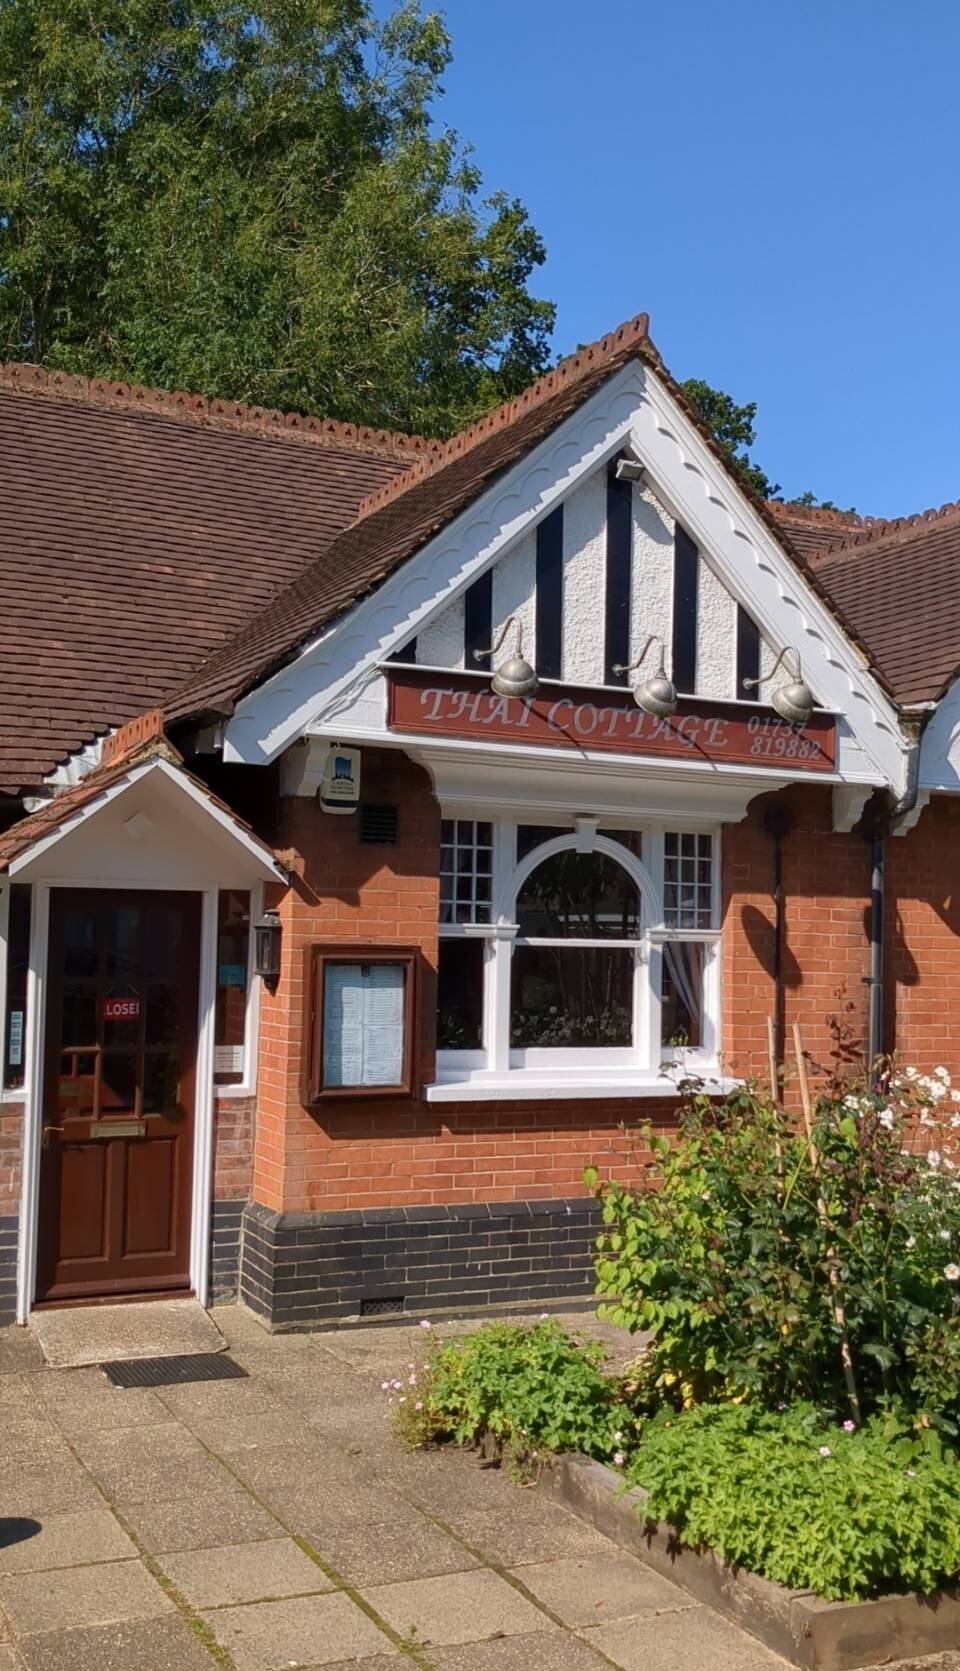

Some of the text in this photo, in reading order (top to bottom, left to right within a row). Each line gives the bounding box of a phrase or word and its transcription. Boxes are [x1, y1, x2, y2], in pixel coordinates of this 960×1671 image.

[420, 687, 730, 749] THAI COTTAGE
[747, 715, 808, 740] 01737
[750, 736, 822, 761] 819882
[104, 1002, 140, 1016] LOSE
